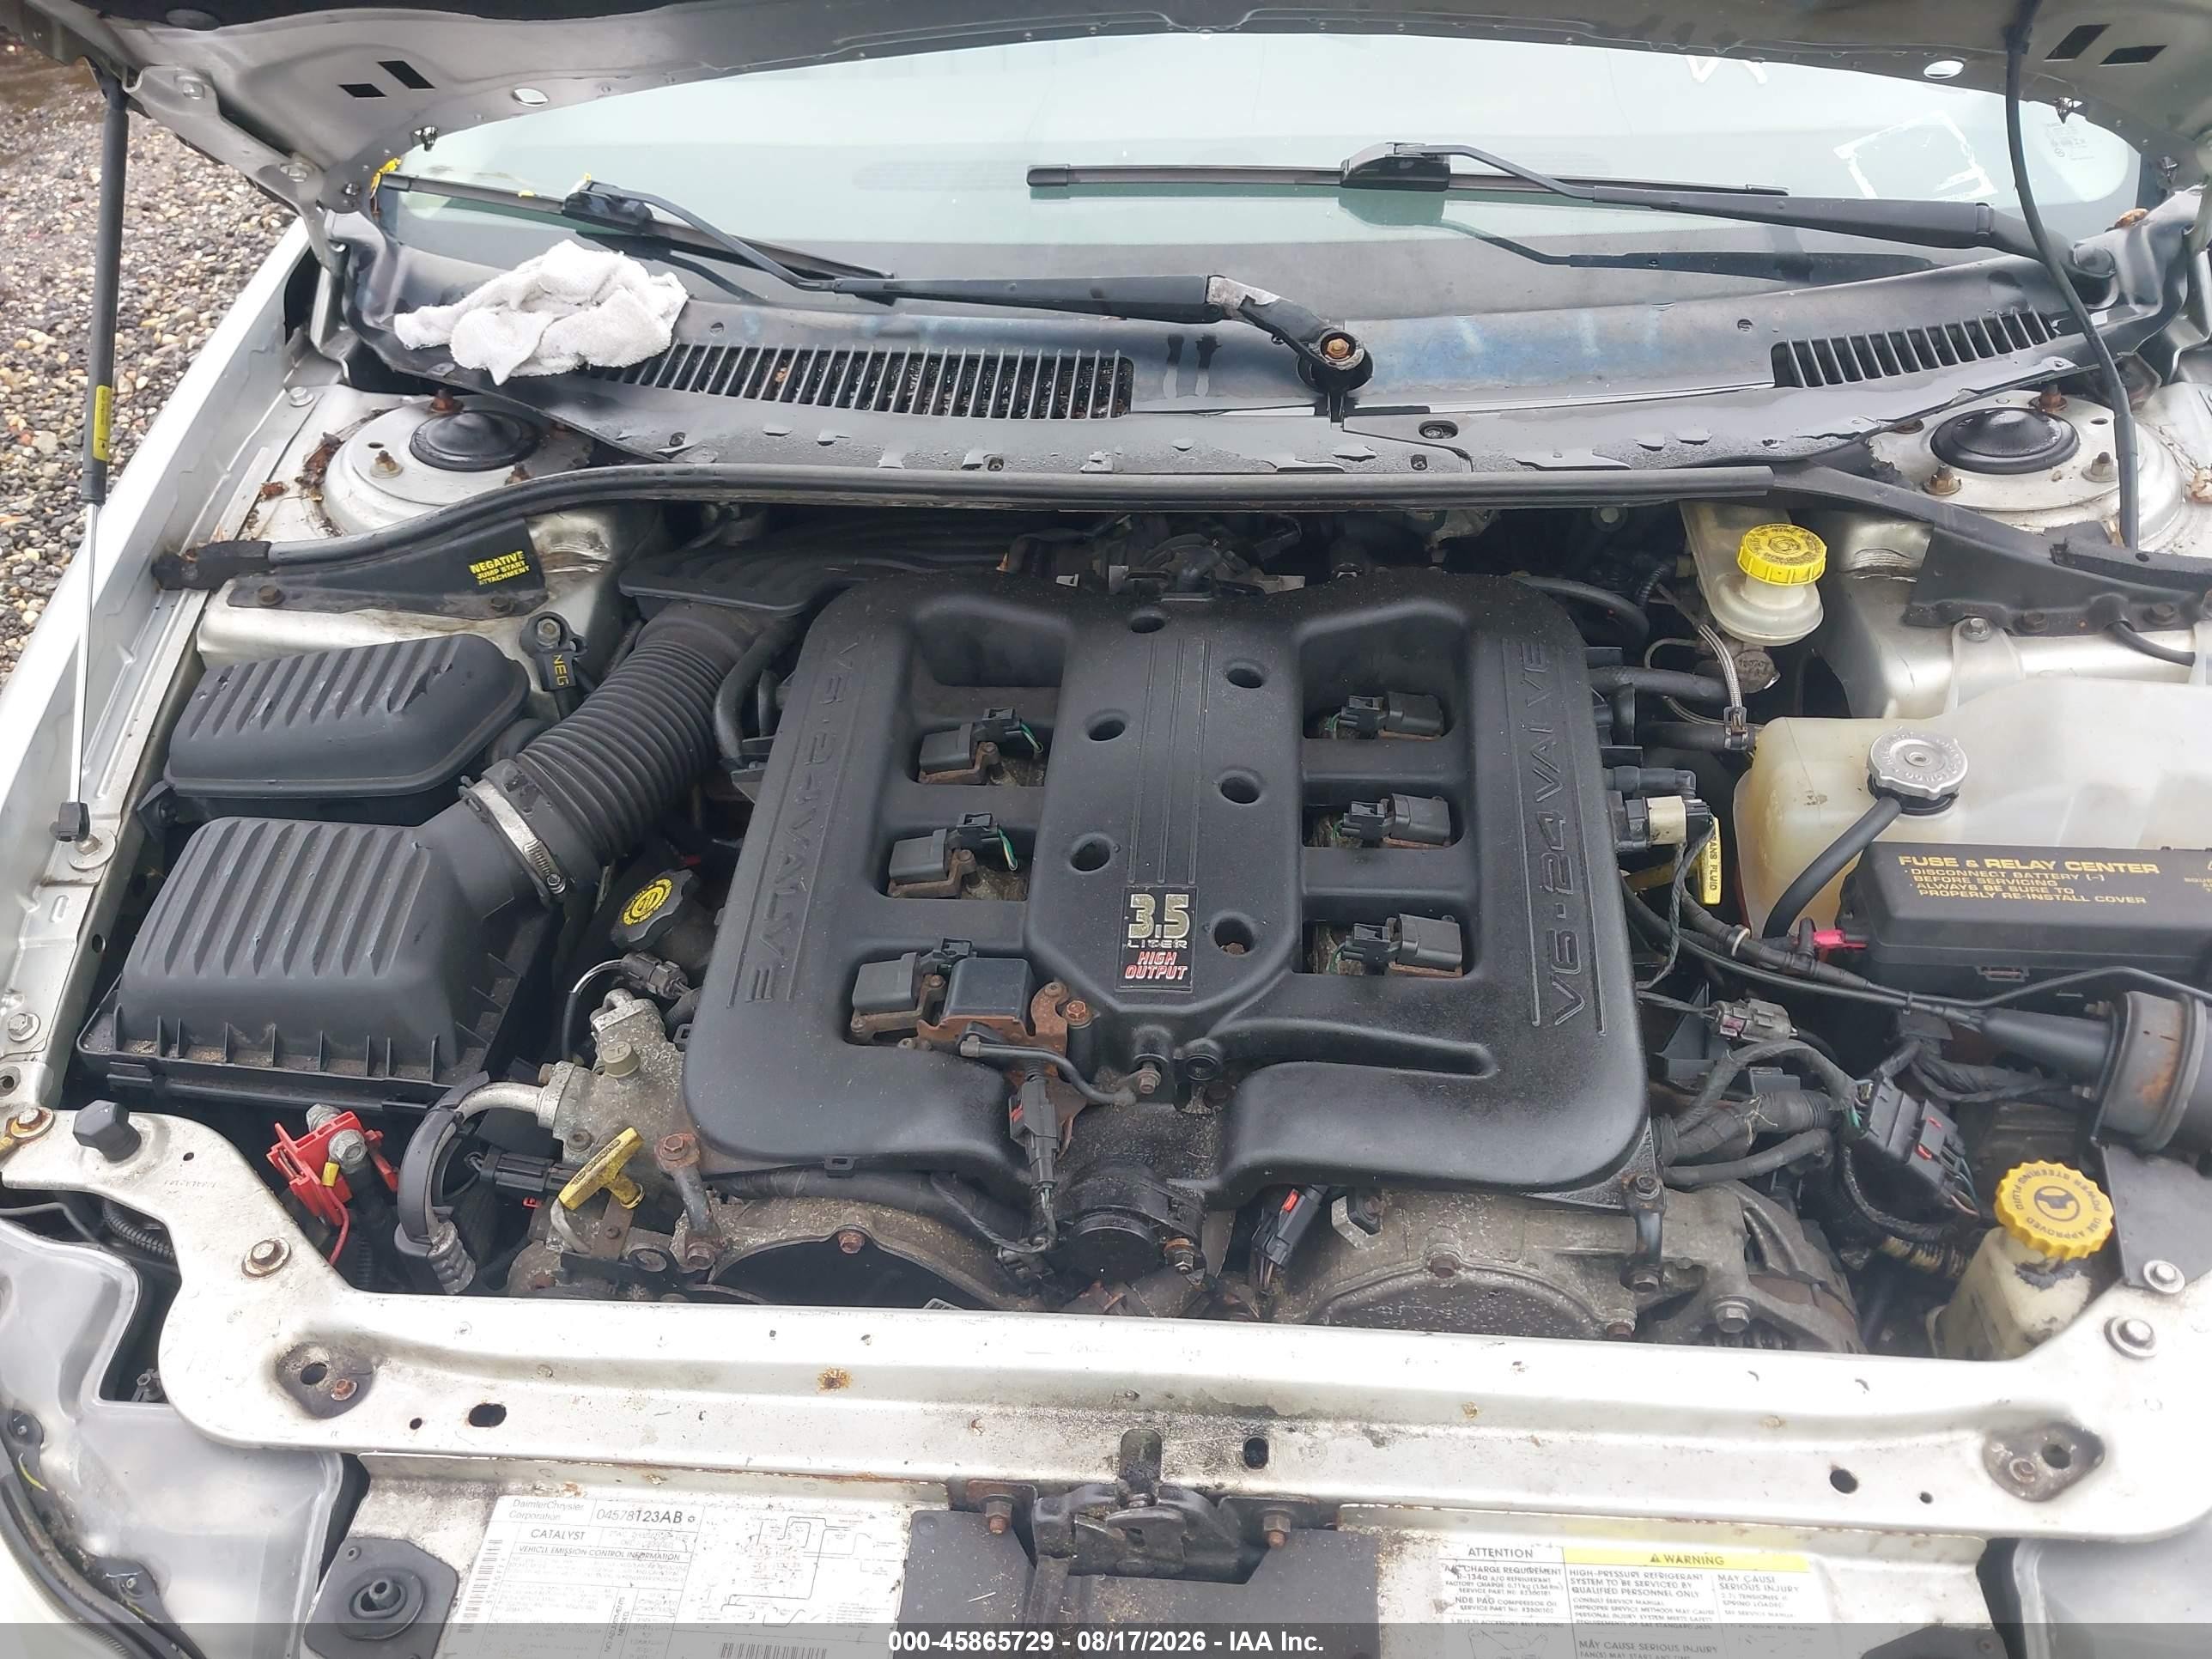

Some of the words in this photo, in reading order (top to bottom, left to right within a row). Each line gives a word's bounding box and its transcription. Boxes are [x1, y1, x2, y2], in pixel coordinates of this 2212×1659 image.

[468, 550, 524, 574] NEGATIVE
[476, 568, 499, 580] JUMP
[501, 560, 526, 573] START
[477, 565, 530, 586] ATTACHMENT
[554, 653, 569, 686] NEG
[1899, 856, 1960, 866] FUSE
[1984, 859, 2057, 871] RELAY
[2064, 861, 2160, 873] CENTER
[1911, 868, 2007, 878] DISCONNECT
[2013, 872, 2079, 880] BATTERY
[1913, 875, 1972, 884] BEFORE
[1978, 877, 2058, 887] SERVICING
[1917, 883, 1978, 891] ALWAYS
[2008, 885, 2048, 894] SURE
[1919, 890, 1996, 899] PROPERLY
[2002, 892, 2091, 902] RE-INSTALL
[2094, 895, 2147, 903] COVER
[1127, 893, 1190, 939] 3.5
[1127, 939, 1188, 949] LITER
[1137, 951, 1177, 965] HIGH
[1125, 964, 1188, 980] OUTPUT
[2018, 1169, 2071, 1185] STEERING
[2012, 1184, 2024, 1211] FLUID
[2074, 1179, 2102, 1212] POWER
[2026, 1216, 2086, 1239] APPROVED
[2087, 1218, 2102, 1233] USE
[512, 1499, 585, 1511] DaimlerChrysler
[508, 1510, 562, 1521] Corporation
[531, 1528, 586, 1540] CATALYST
[519, 1546, 549, 1554] VEHICLE
[550, 1547, 587, 1556] EMISSION
[589, 1549, 625, 1559] CONTROL
[626, 1551, 681, 1561] INFORMATION
[1468, 1547, 1534, 1559] ATTENTION
[1663, 1553, 1725, 1565] WARNING
[1464, 1565, 1501, 1574] CHARGE
[1503, 1566, 1562, 1577] REQUIREMENT
[1569, 1569, 1640, 1578] HIGH-PRESSURE
[1644, 1571, 1704, 1581] REFRIGERANT
[1571, 1577, 1603, 1586] SYSTEM
[1606, 1578, 1619, 1587] TO
[1634, 1580, 1679, 1589] SERVICED
[1681, 1581, 1692, 1589] BY
[1717, 1573, 1740, 1582] MAY
[1743, 1575, 1776, 1583] CAUSE
[1571, 1586, 1619, 1595] QUALIFIED
[1621, 1588, 1674, 1597] PERSONNEL
[1676, 1589, 1699, 1598] ONLY
[1719, 1582, 1760, 1591] SERIOUS
[1764, 1584, 1800, 1593] INJURY
[1579, 1639, 1601, 1650] MAY
[1603, 1642, 1635, 1650] CAUSE
[1638, 1643, 1680, 1652] SERIOUS
[1683, 1644, 1718, 1654] INJURY
